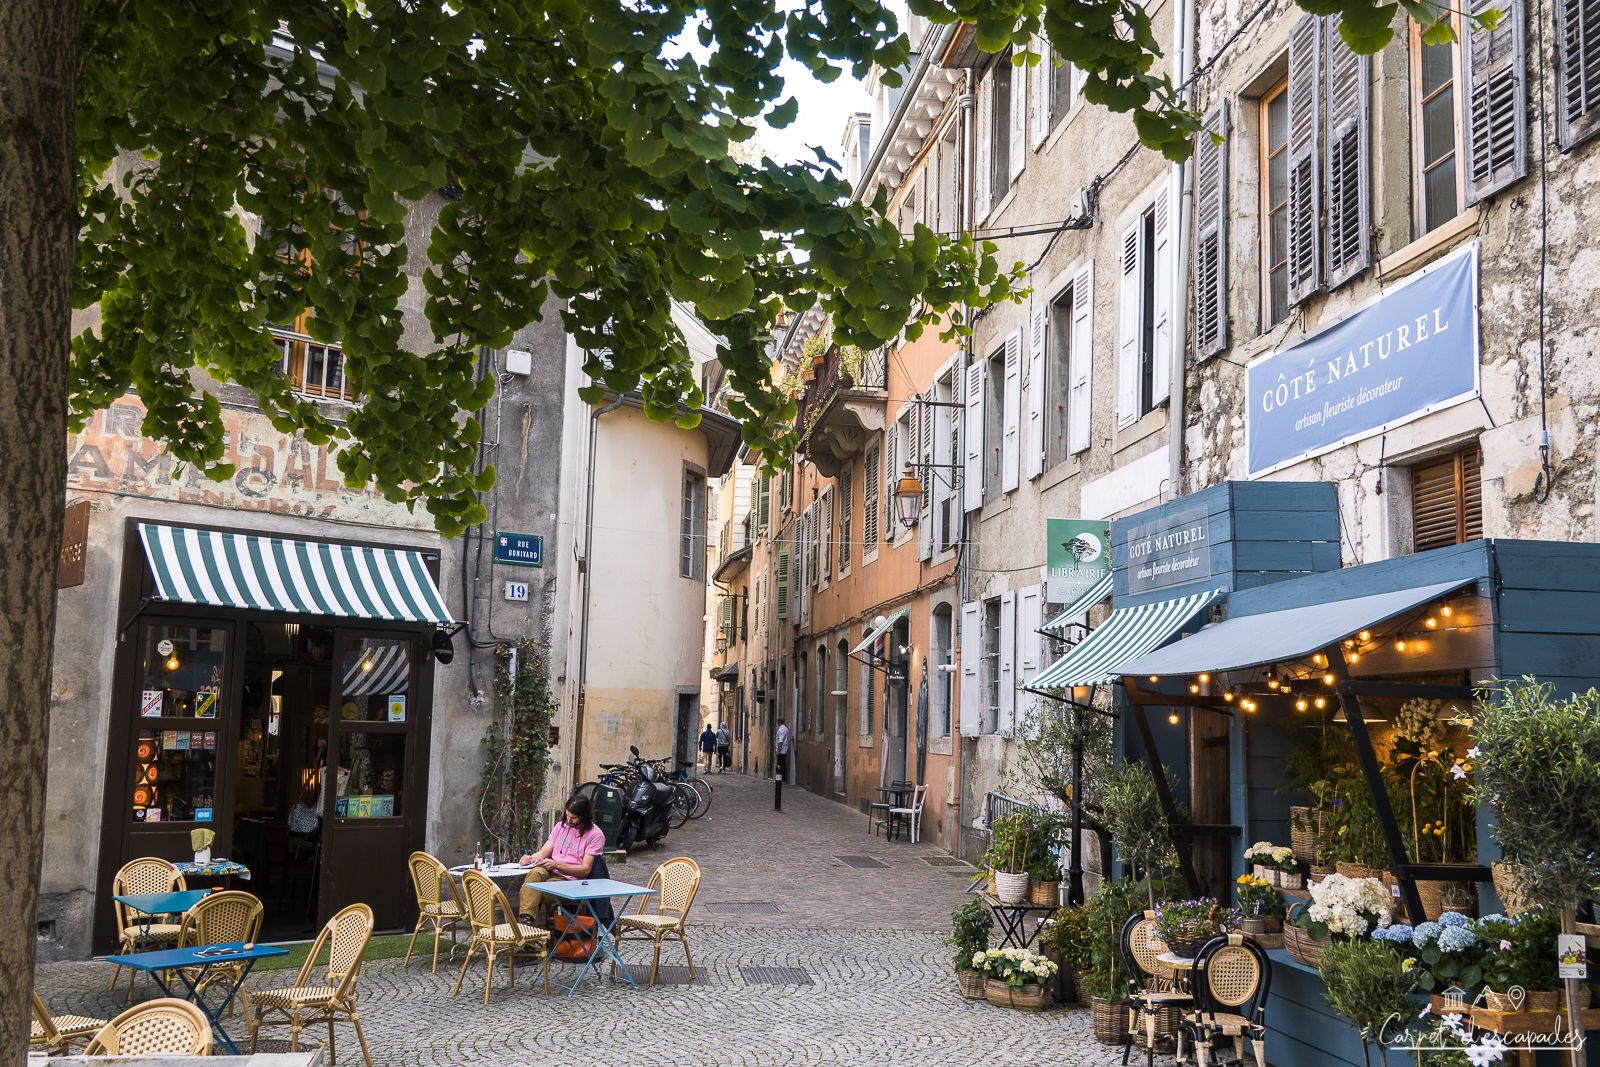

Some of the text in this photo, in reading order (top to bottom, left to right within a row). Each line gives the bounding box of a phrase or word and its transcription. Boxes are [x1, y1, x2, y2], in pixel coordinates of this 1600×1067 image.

[1262, 306, 1449, 412] CÔTÉ NATUREL
[1295, 376, 1403, 431] artisan fleuriste décorateur
[517, 540, 529, 548] RUE
[1155, 526, 1205, 552] NATUREL
[508, 549, 538, 559] BONIVARD
[1137, 555, 1200, 580] artisan fleuriste décorateur
[509, 584, 525, 598] 19
